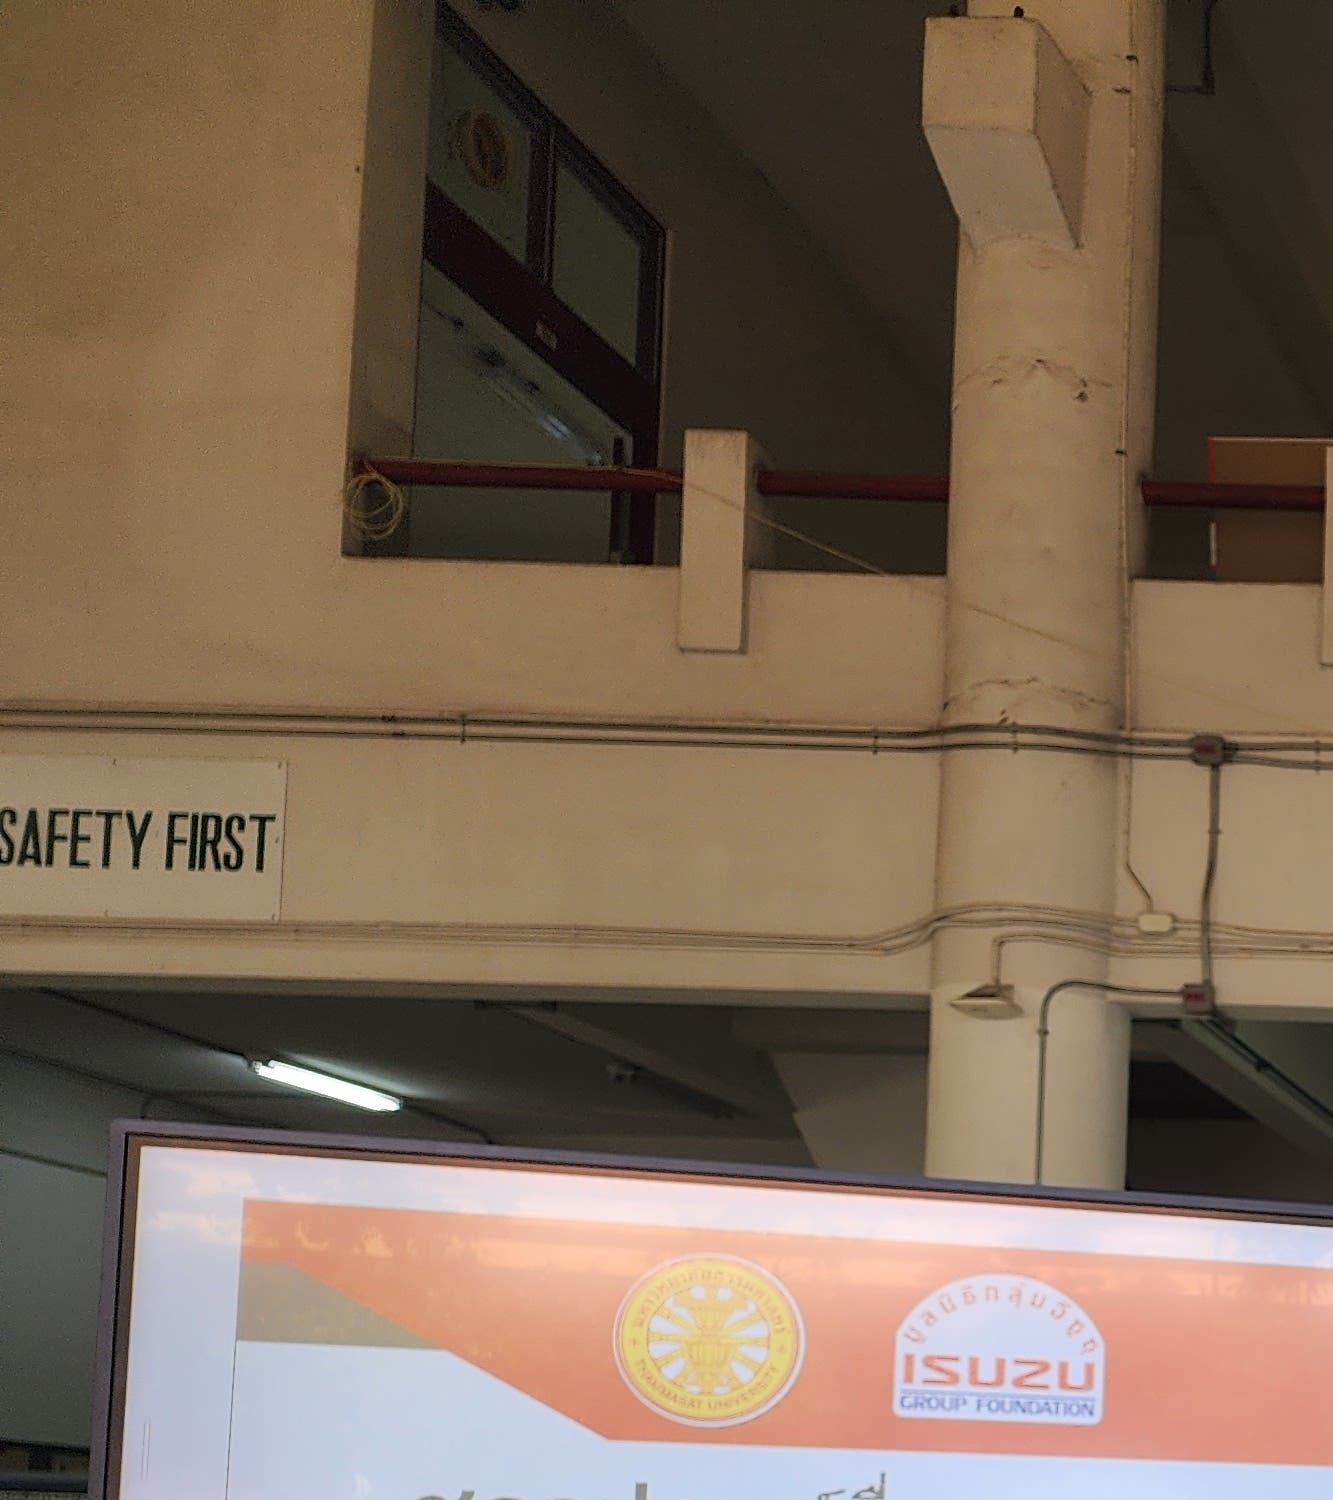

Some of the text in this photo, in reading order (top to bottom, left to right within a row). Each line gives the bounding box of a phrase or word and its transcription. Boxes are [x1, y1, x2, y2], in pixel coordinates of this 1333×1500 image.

[0, 807, 276, 873] SAFETY FIRST
[903, 1353, 1095, 1391] ISUZU
[900, 1396, 1095, 1417] GROUP FOUNDATION
